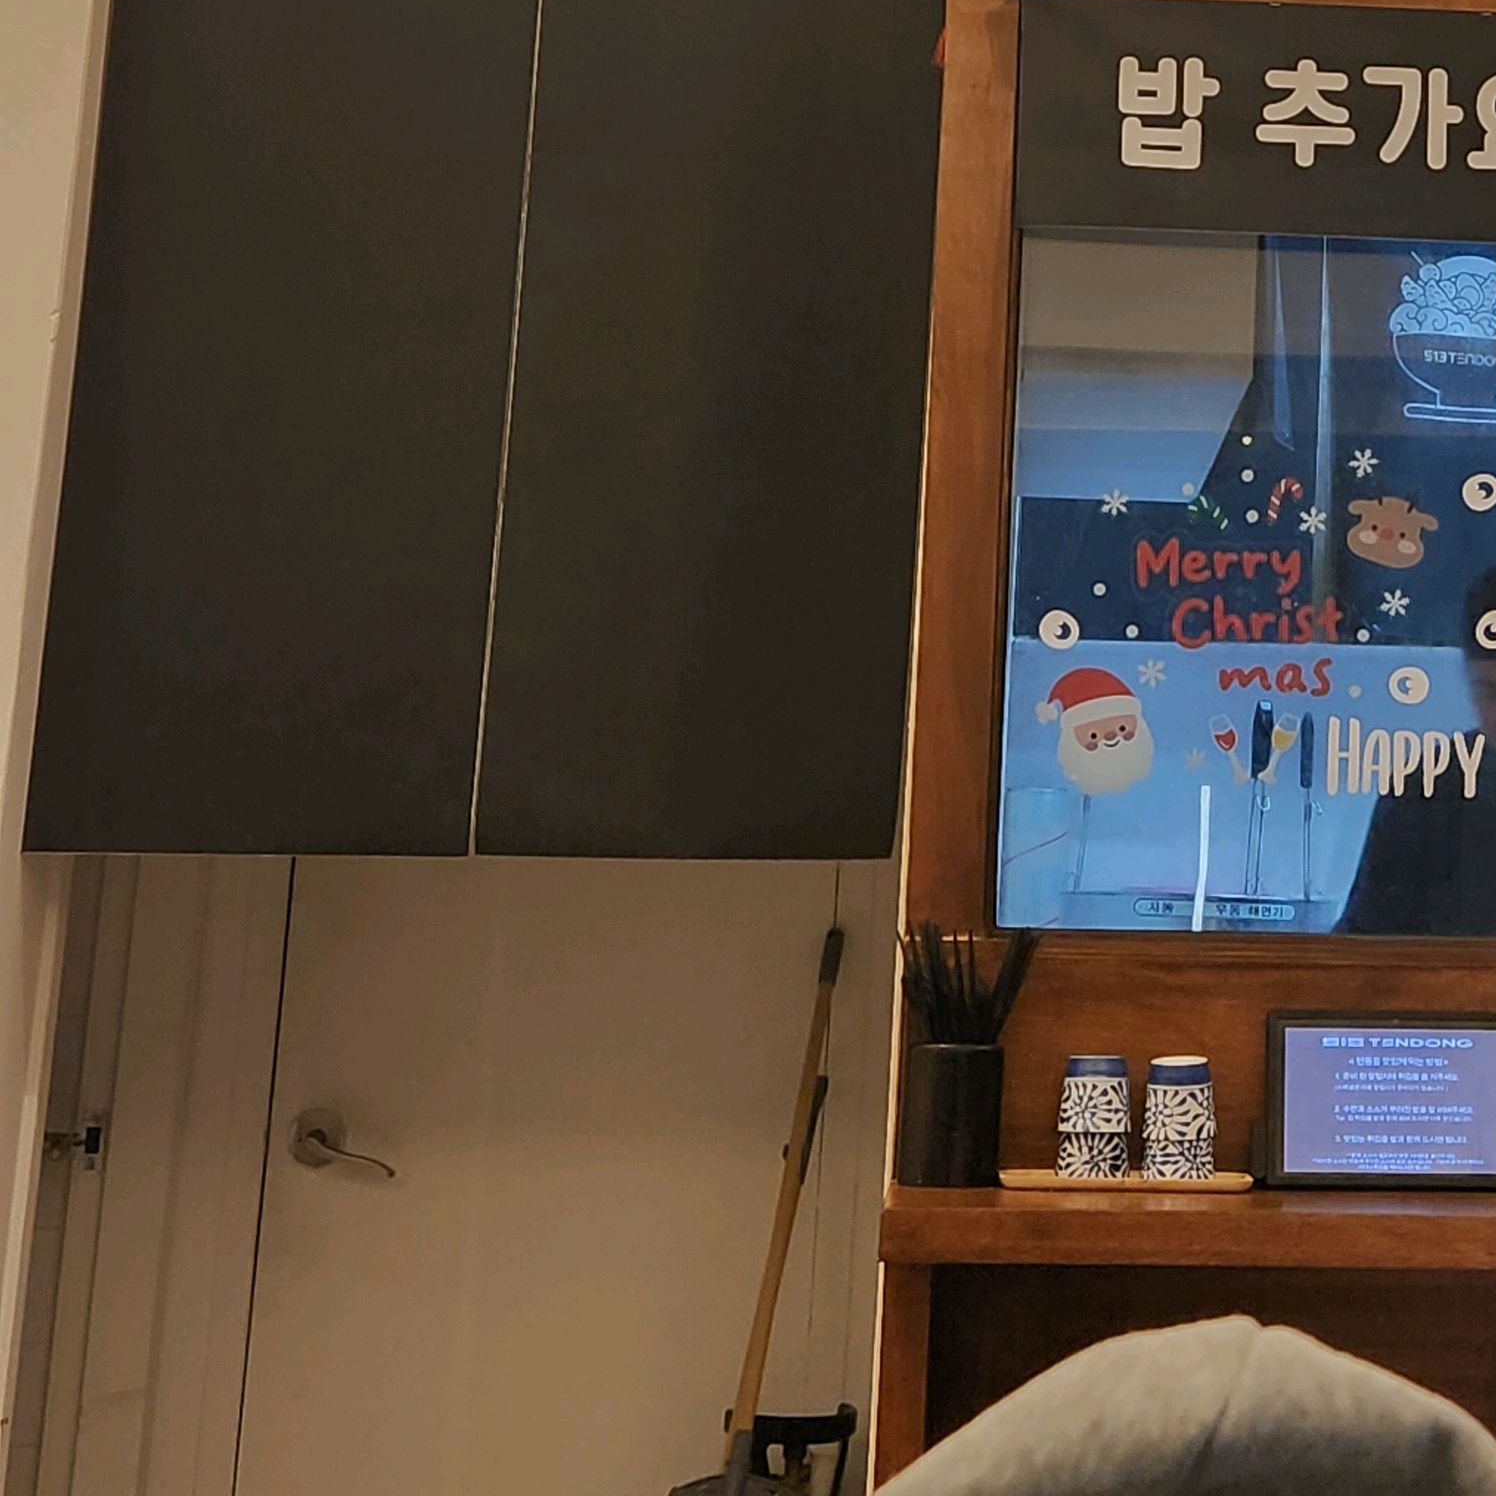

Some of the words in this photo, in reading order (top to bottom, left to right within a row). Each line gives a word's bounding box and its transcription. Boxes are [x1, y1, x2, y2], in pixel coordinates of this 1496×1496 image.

[1118, 56, 1221, 170] 밥
[1136, 538, 1301, 595] Merry
[1172, 596, 1343, 649] Christ
[1219, 658, 1333, 697] mas
[1327, 716, 1486, 800] HAPPY
[1369, 1037, 1474, 1049] TENDONG
